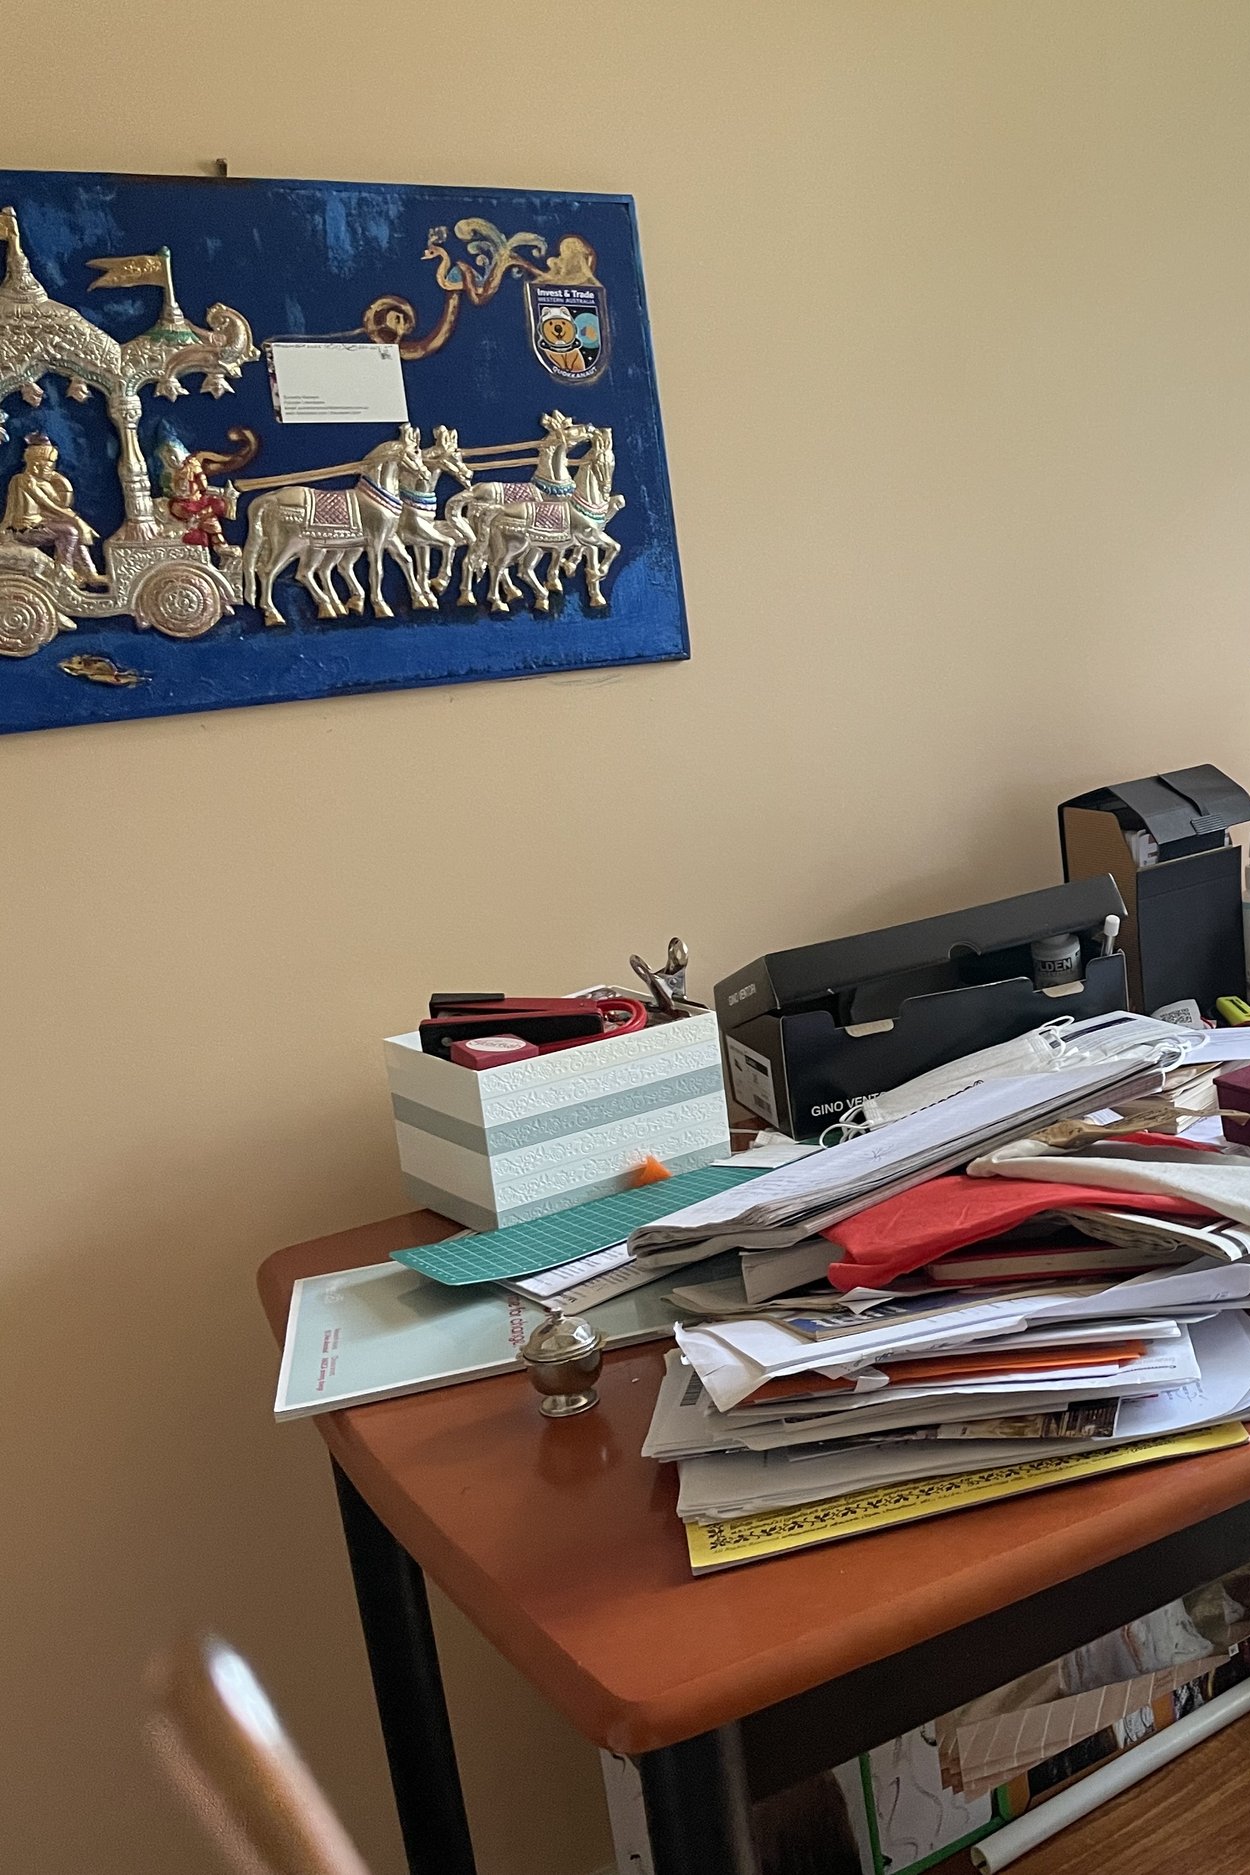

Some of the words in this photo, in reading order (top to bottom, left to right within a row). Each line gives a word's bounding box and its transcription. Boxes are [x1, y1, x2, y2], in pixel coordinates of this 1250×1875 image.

[537, 288, 563, 298] Invest
[564, 289, 571, 298] &
[571, 289, 595, 299] Trade
[811, 1101, 844, 1117] GINO
